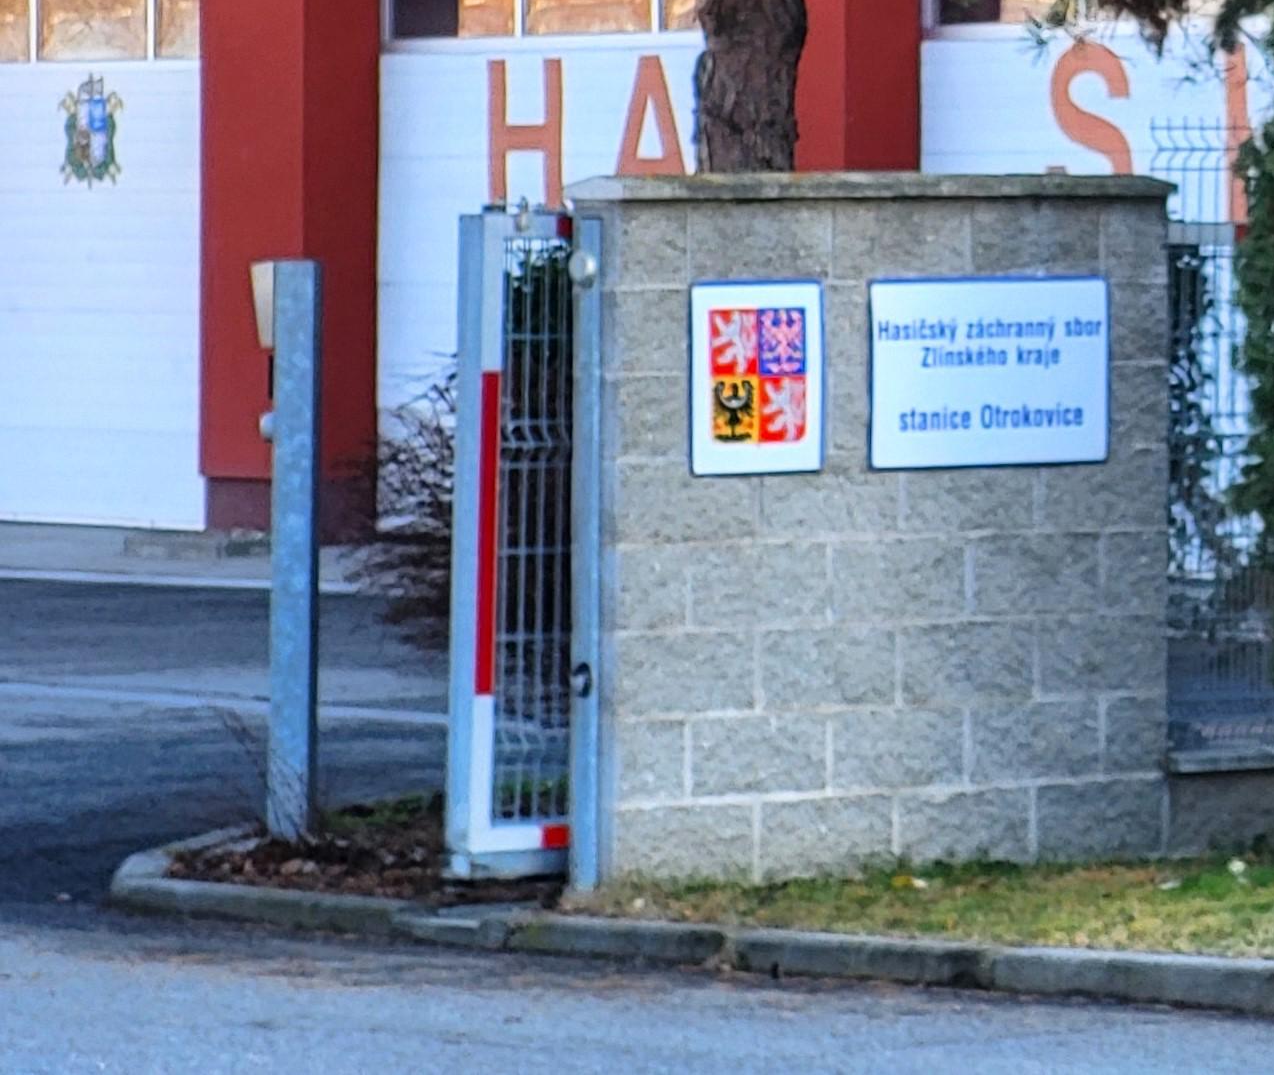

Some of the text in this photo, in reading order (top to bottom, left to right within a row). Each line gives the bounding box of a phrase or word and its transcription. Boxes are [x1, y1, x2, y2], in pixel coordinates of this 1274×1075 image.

[877, 315, 1102, 344] Hasičský záchranný sbor
[1016, 344, 1061, 369] kraje
[899, 402, 1085, 432] stanice Otrokovice
